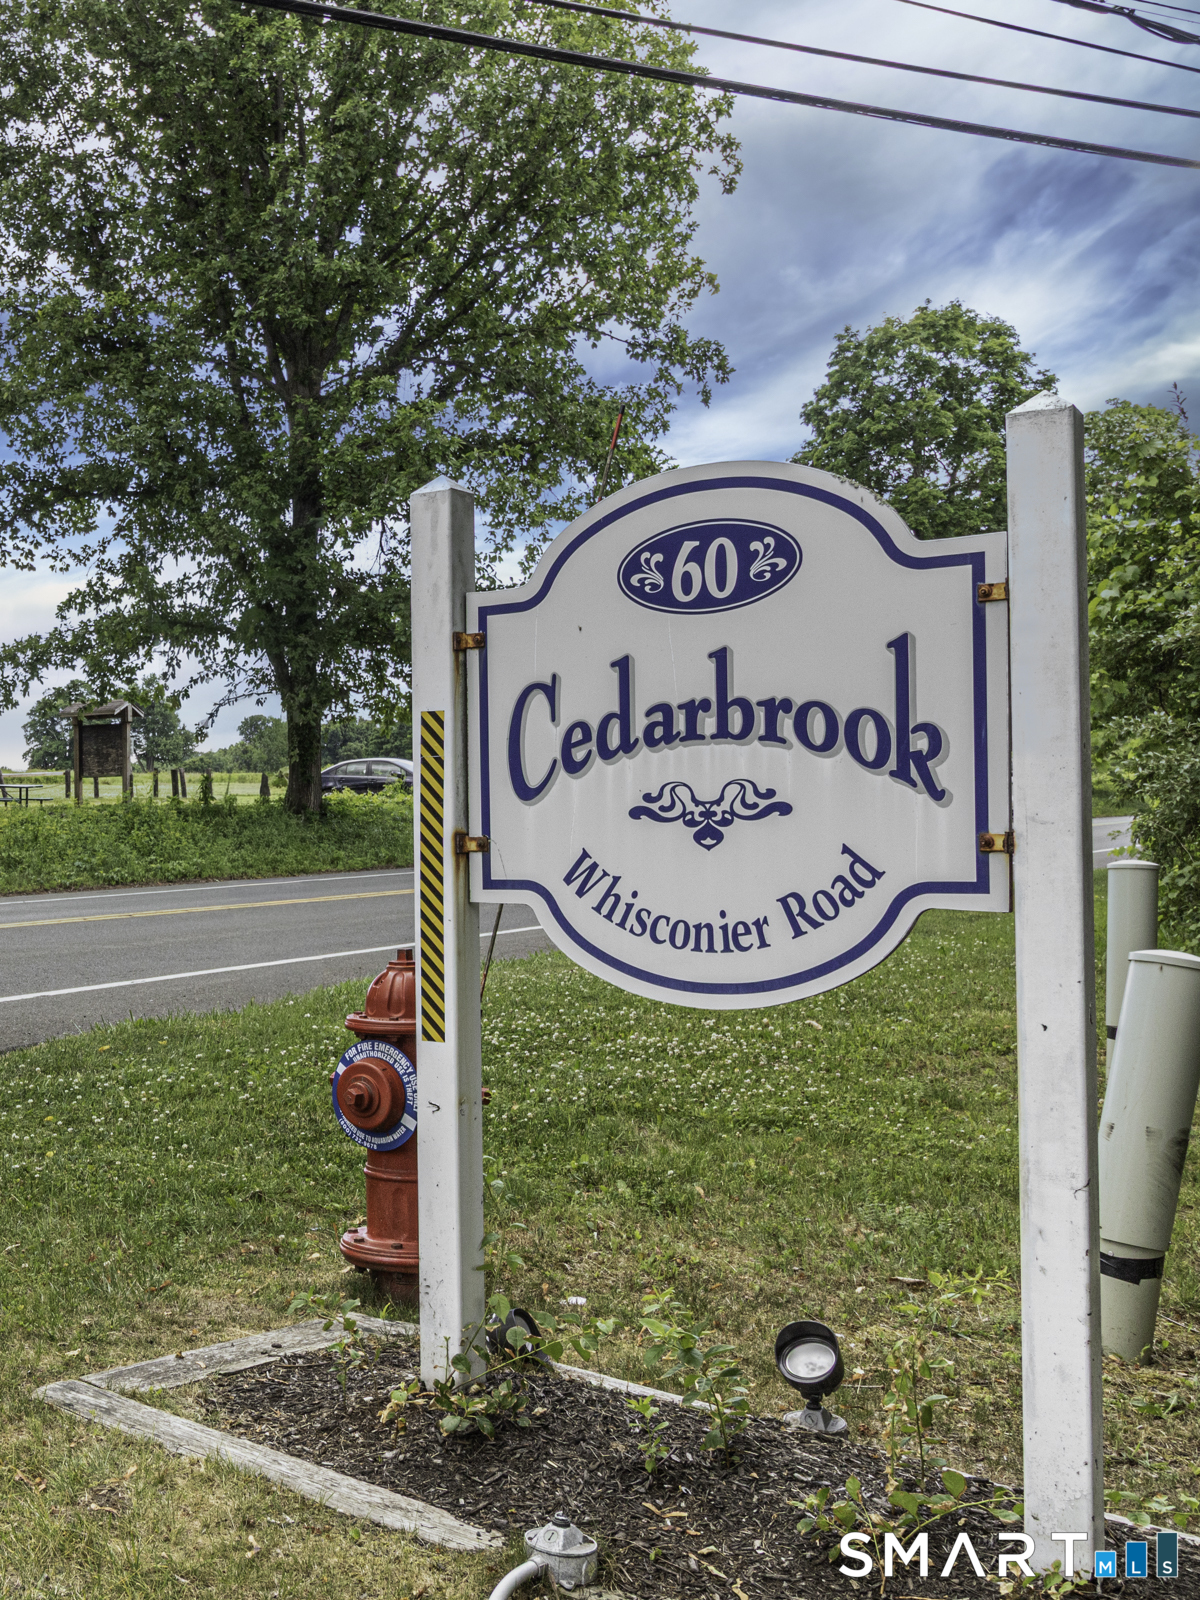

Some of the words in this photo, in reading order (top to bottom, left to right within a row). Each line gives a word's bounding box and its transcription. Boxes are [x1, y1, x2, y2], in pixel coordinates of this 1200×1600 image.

[671, 536, 739, 603] 60
[507, 631, 952, 807] Cedarbrook
[562, 847, 772, 955] Whisconier
[776, 842, 887, 940] Road
[344, 1046, 358, 1061] FOR
[357, 1041, 373, 1052] FIRE
[374, 1042, 414, 1074] EMERGENCY
[352, 1050, 394, 1064] UNAUTHORIZED
[394, 1062, 405, 1075] USE
[402, 1074, 409, 1082] IS
[405, 1084, 414, 1106] THEFT
[338, 1118, 352, 1136] (800)
[365, 1134, 371, 1142] TO
[392, 1125, 406, 1140] WATER
